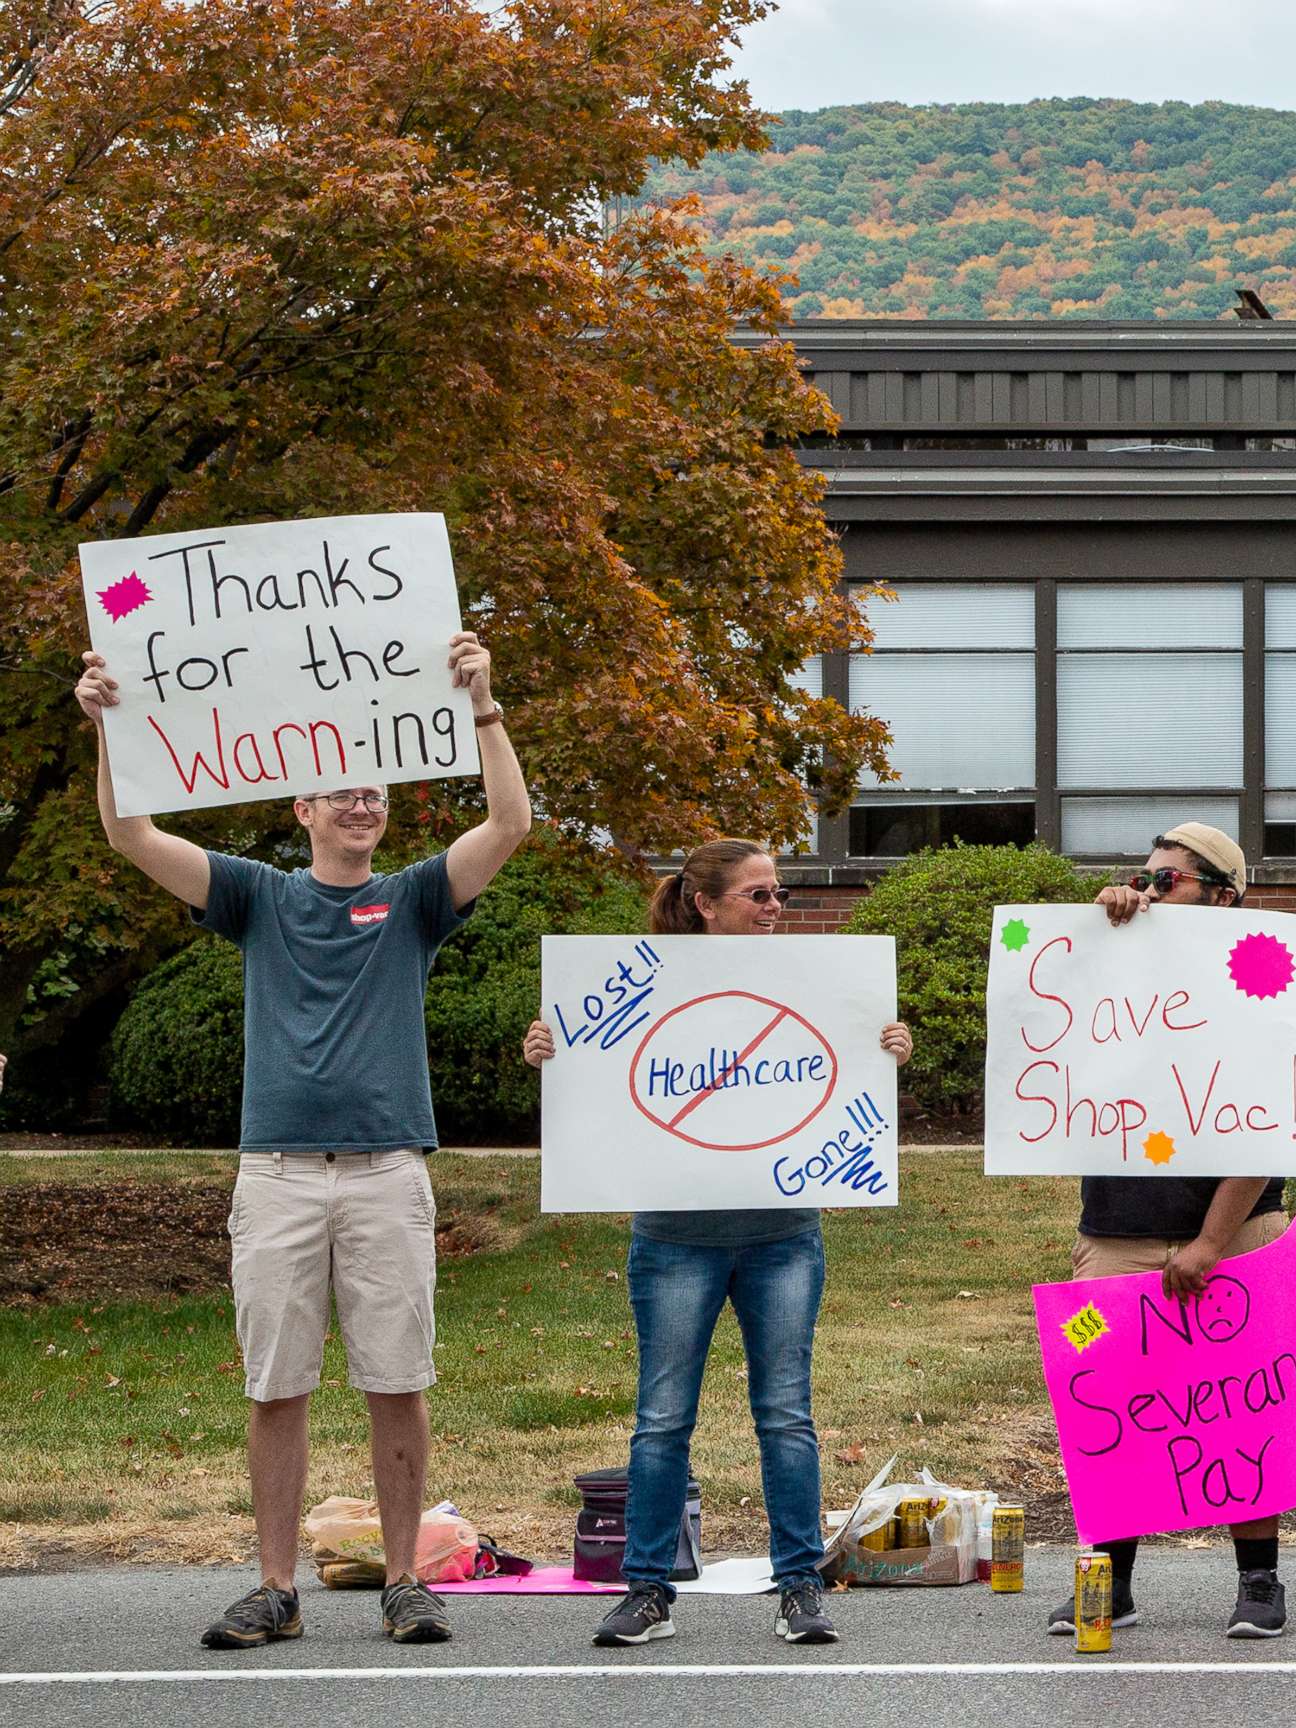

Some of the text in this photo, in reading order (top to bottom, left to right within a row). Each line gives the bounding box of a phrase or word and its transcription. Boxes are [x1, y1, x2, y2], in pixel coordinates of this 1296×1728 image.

[147, 540, 403, 626] Thanks
[143, 624, 420, 703] for the
[147, 699, 457, 795] Warn-ing
[554, 940, 664, 1047] Lost!!
[1021, 937, 1207, 1052] Save
[649, 1048, 826, 1097] Healthcare
[1016, 1061, 1147, 1161] Shop
[773, 1092, 889, 1196] Gone!!!
